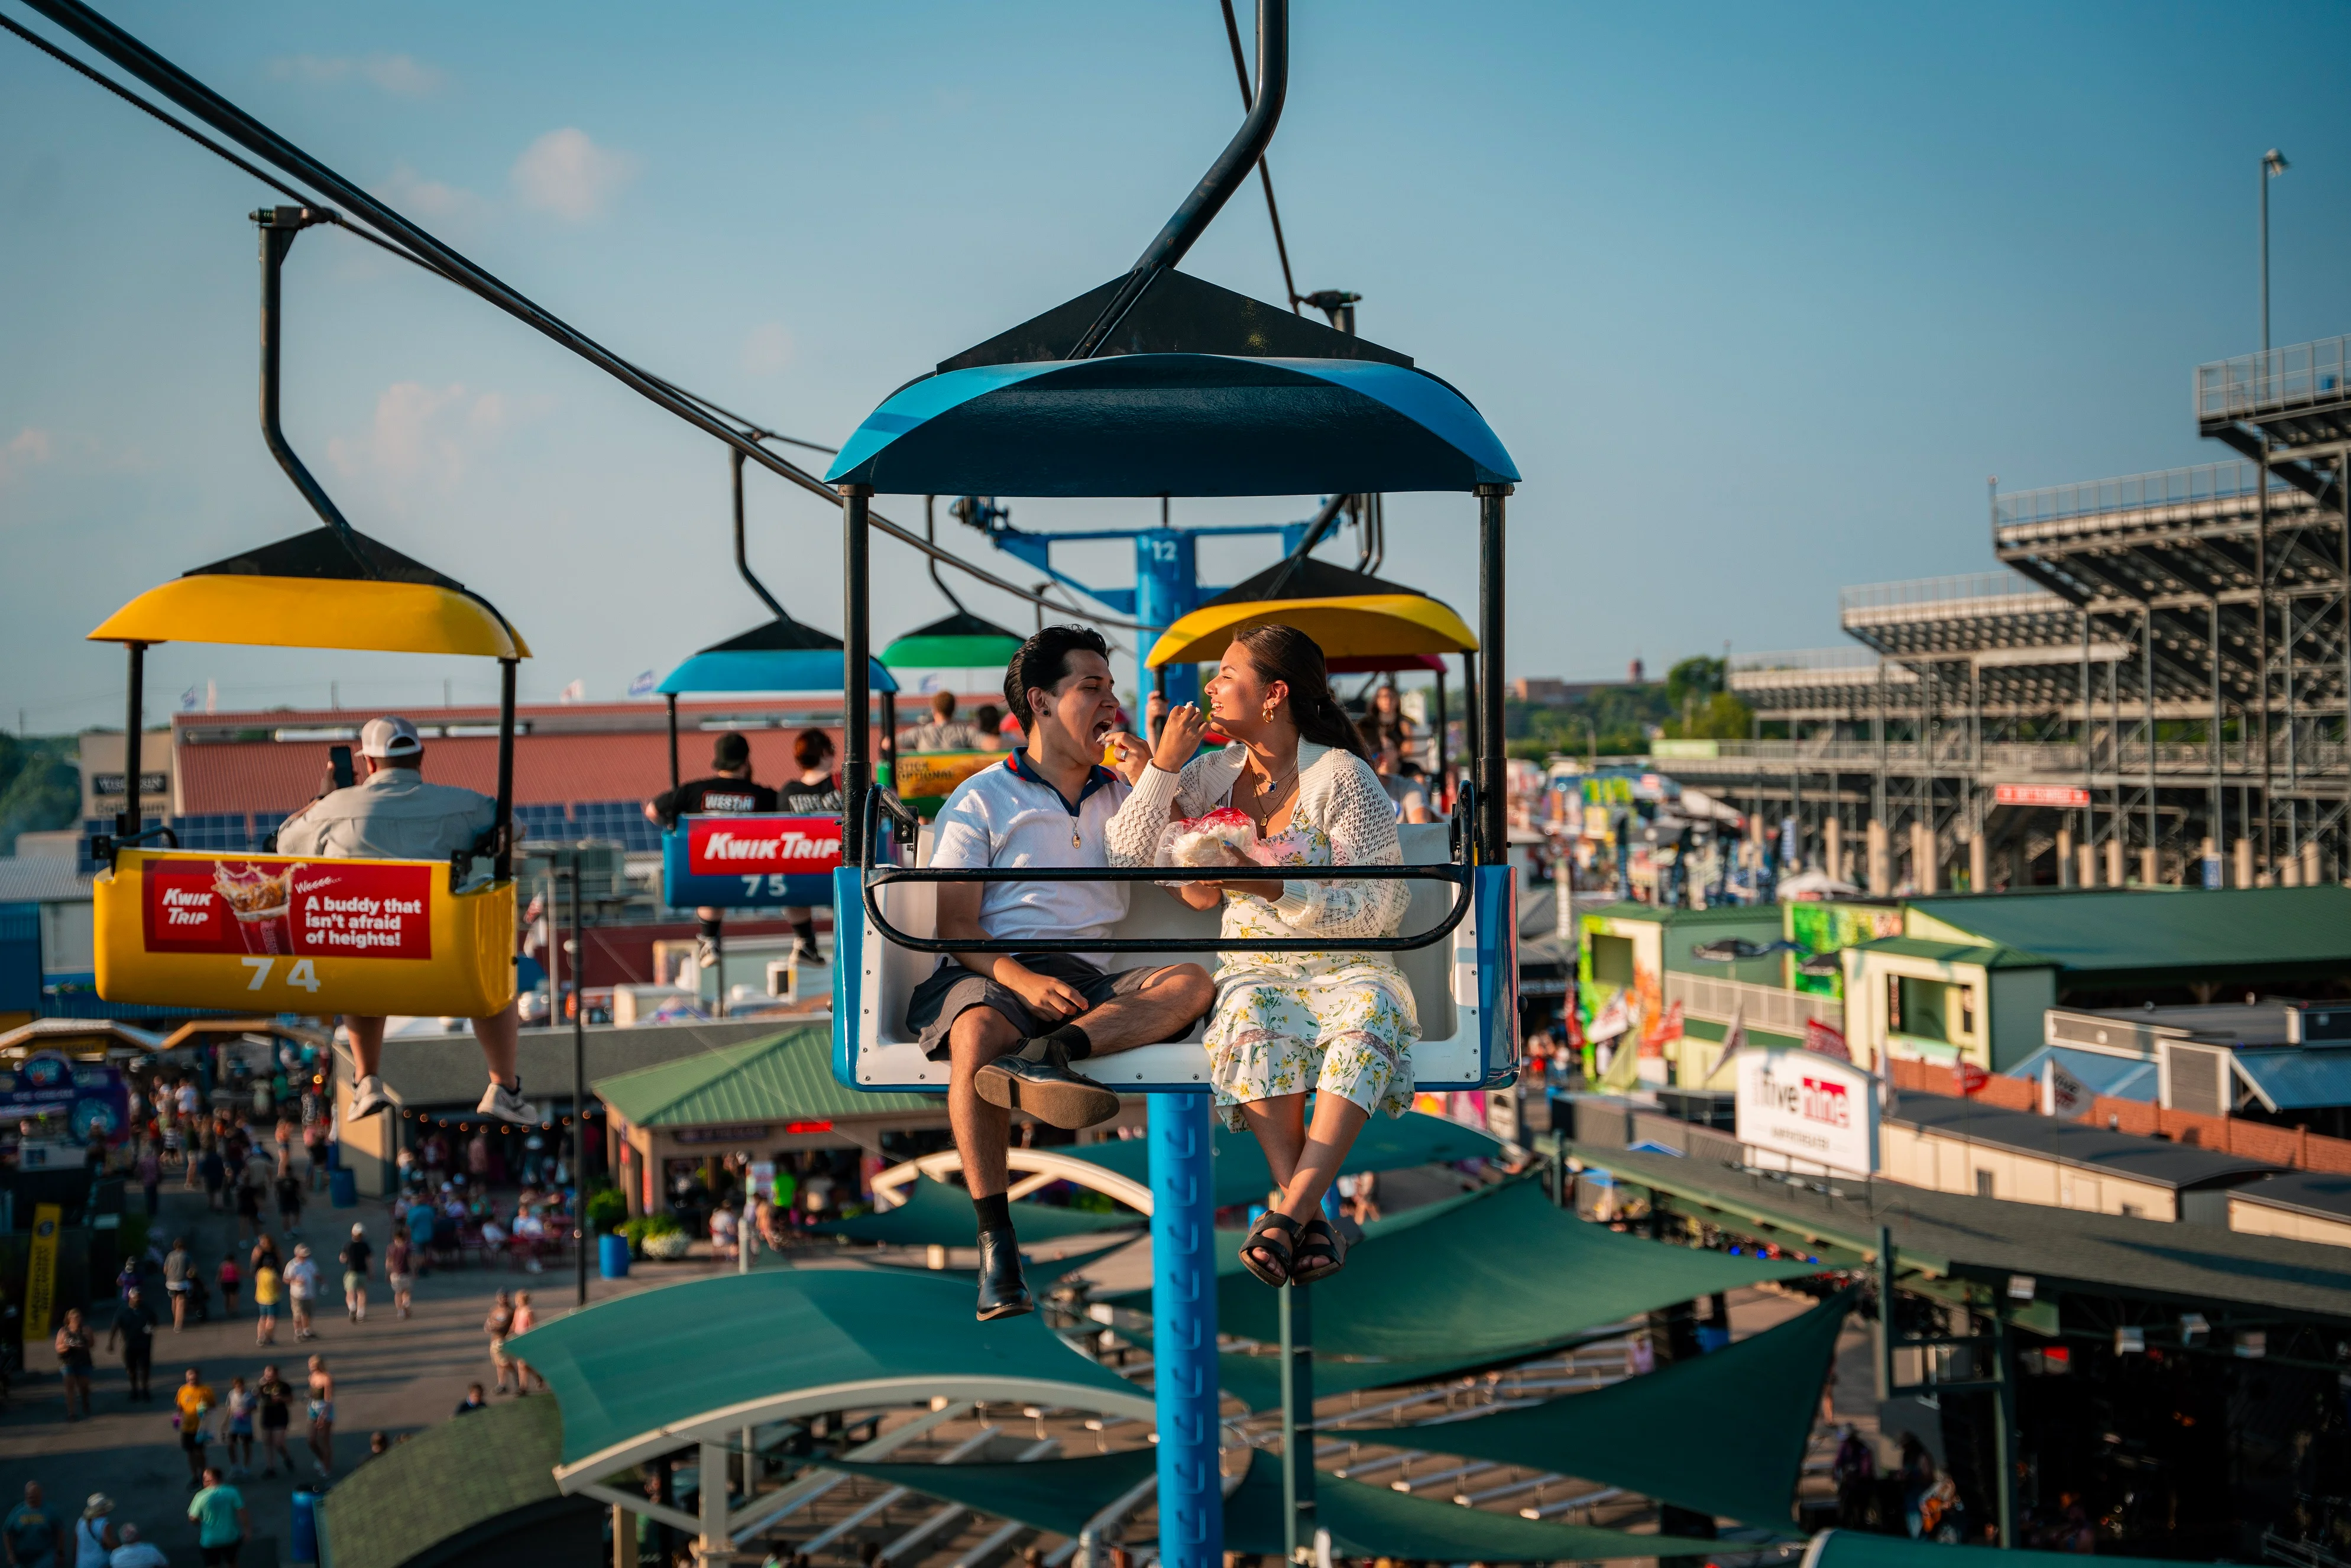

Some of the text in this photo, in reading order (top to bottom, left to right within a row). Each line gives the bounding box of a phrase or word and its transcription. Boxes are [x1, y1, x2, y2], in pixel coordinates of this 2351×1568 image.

[1151, 540, 1177, 561] 12
[704, 831, 841, 860] KWIK TRIP
[740, 873, 788, 898] 75
[162, 888, 213, 906] KWIK
[305, 896, 422, 915] A buddy that
[167, 907, 209, 925] TRIP
[305, 912, 402, 931] isn't afraid
[305, 930, 402, 950] of heights!
[240, 957, 321, 993] 74
[1803, 1080, 1849, 1127] nine
